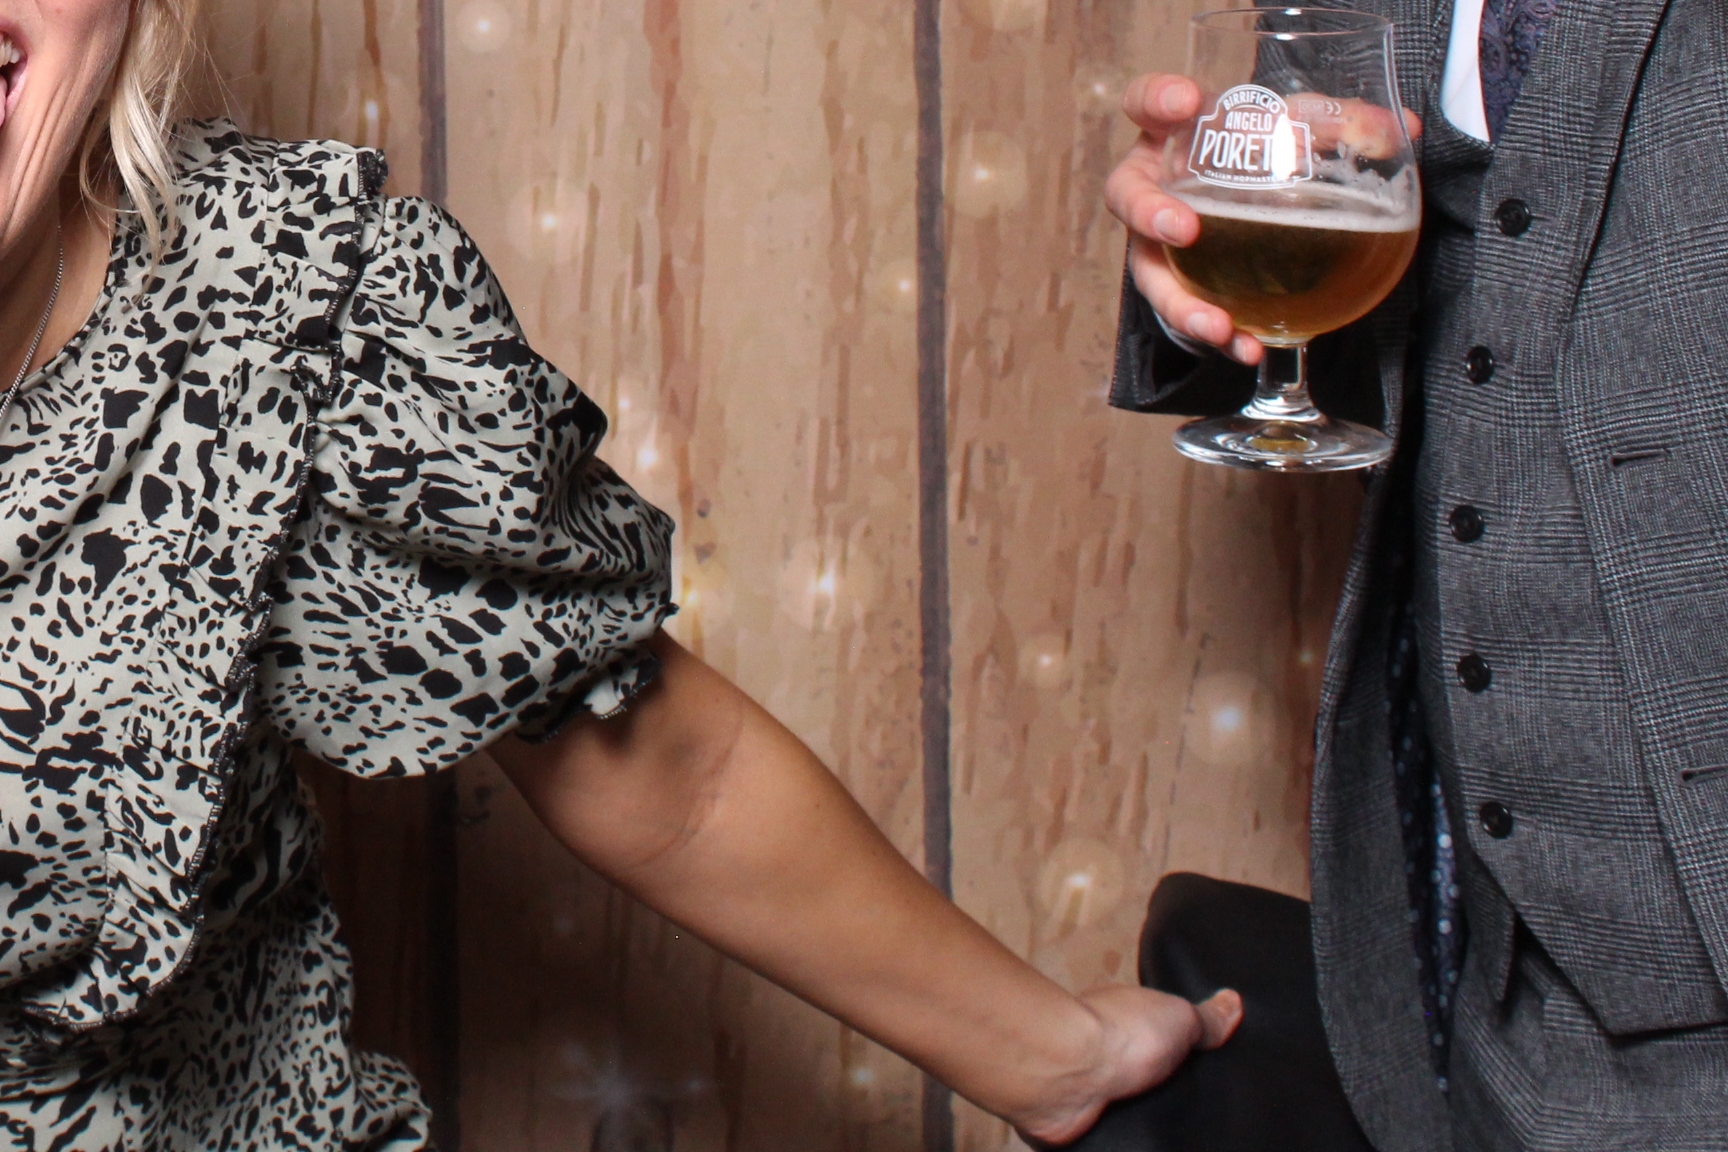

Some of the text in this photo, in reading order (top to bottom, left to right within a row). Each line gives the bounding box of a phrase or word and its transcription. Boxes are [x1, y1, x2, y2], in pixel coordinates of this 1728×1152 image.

[1222, 90, 1281, 114] BIRRIFICIO
[1224, 111, 1273, 132] ANGELO
[1198, 129, 1296, 171] PORET
